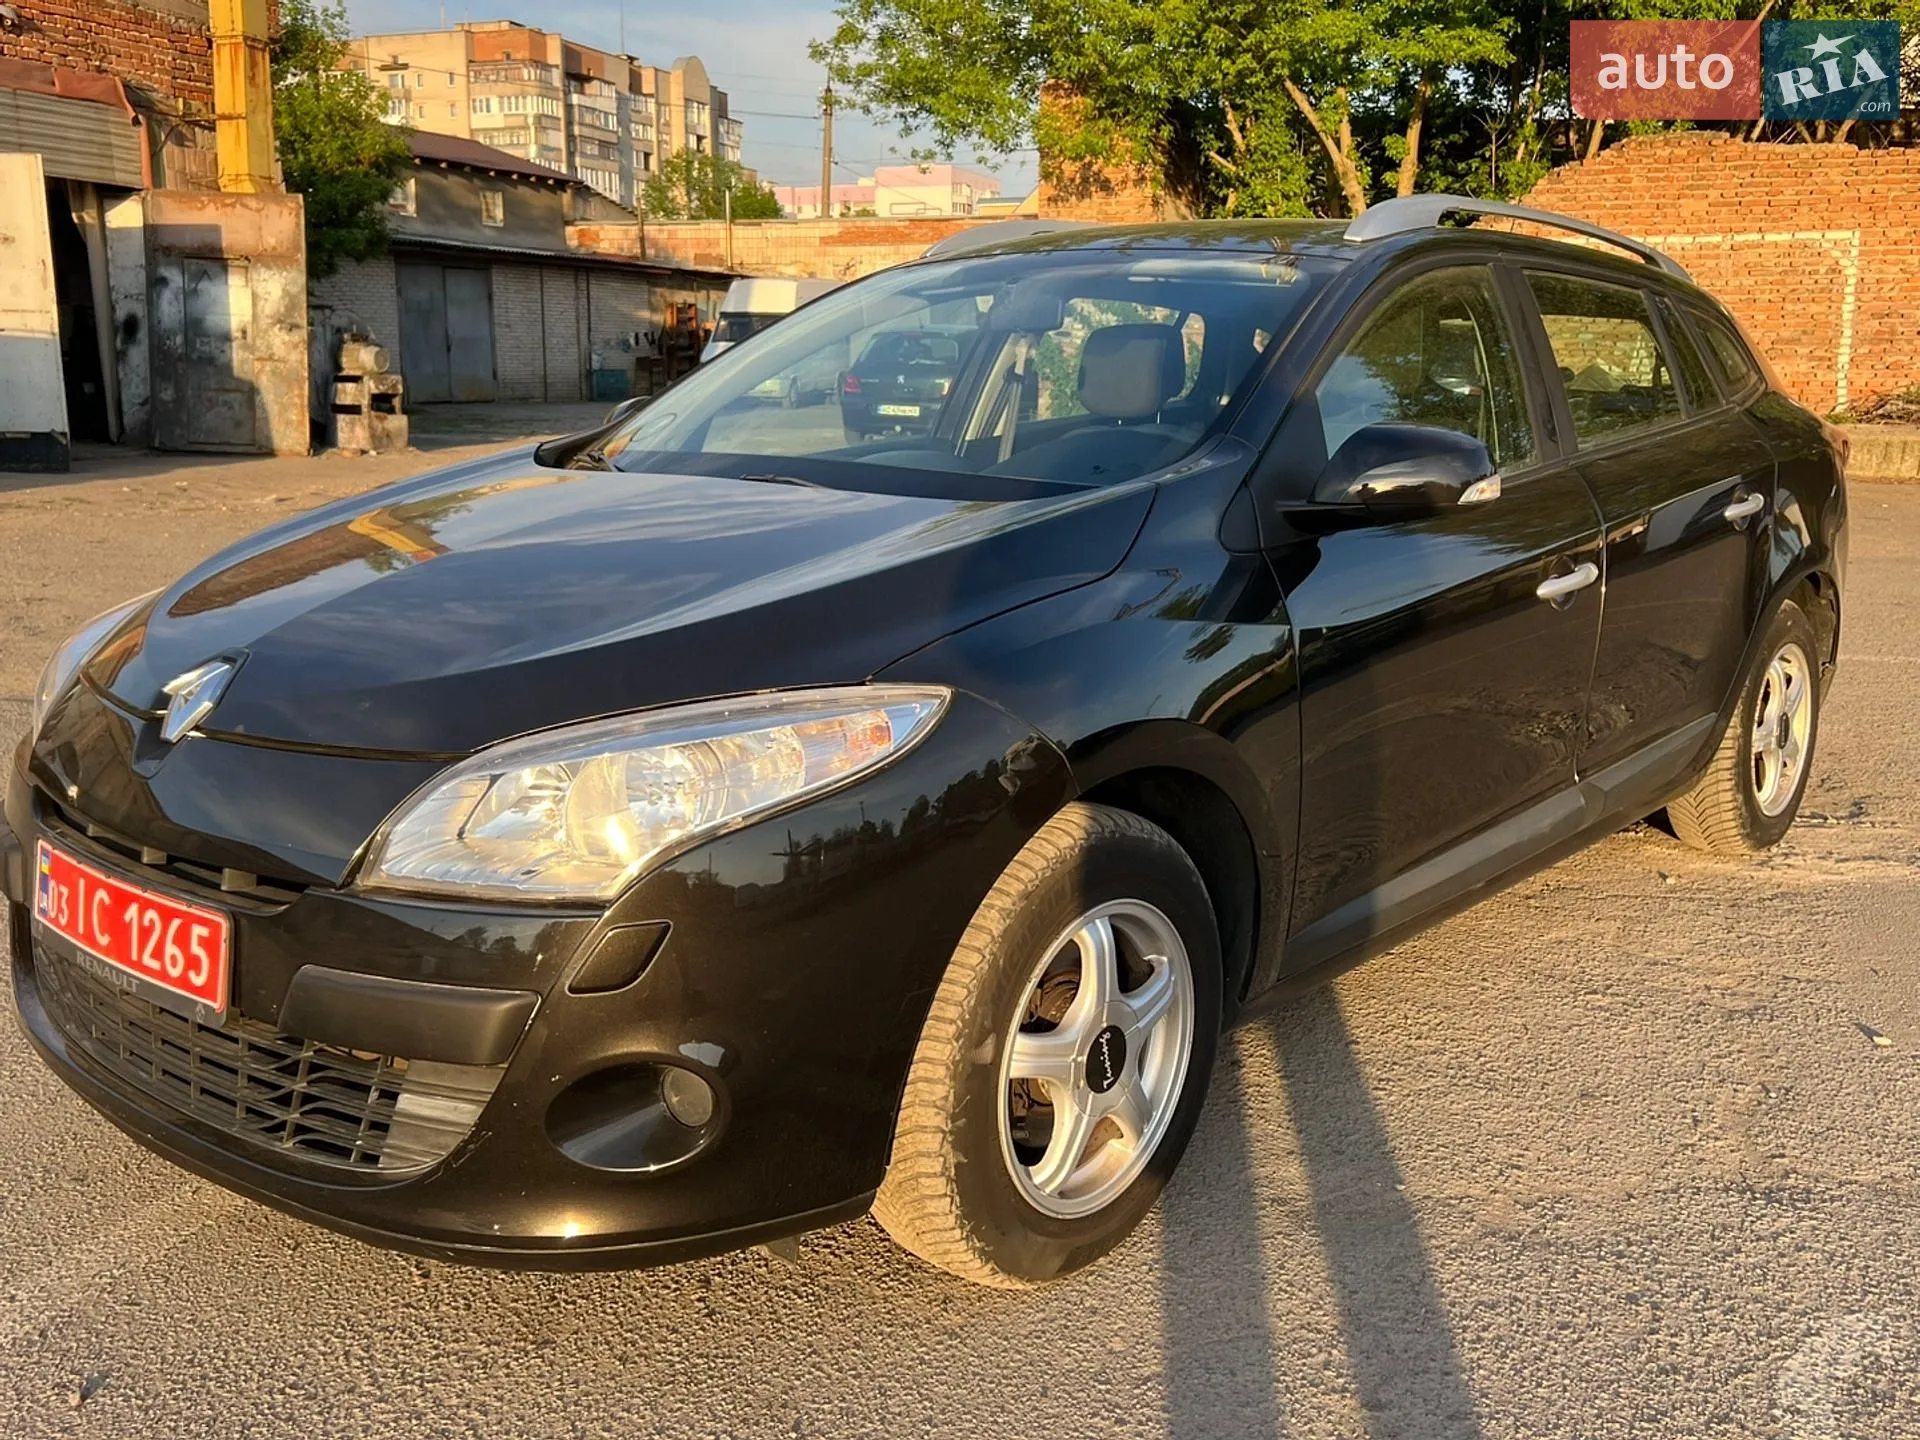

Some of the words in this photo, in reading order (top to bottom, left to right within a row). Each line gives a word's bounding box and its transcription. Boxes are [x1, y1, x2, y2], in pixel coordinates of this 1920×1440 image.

[48, 879, 69, 927] 03
[78, 878, 111, 946] IC
[123, 903, 210, 987] 1265
[76, 949, 140, 993] RENAULT
